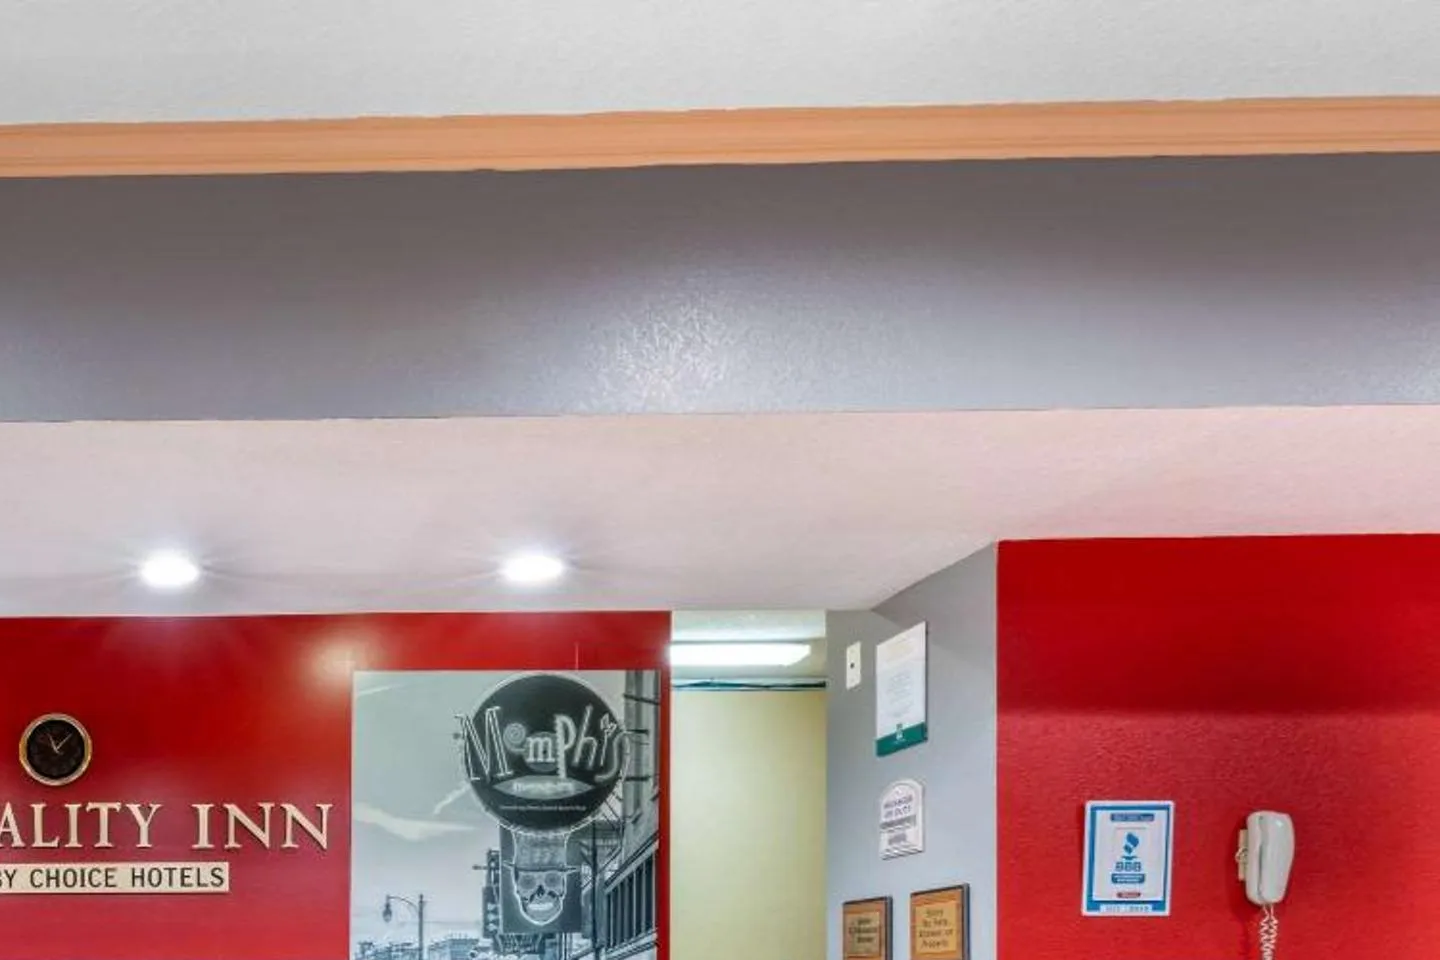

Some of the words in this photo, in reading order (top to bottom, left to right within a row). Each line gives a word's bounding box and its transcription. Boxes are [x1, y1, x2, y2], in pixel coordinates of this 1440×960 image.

[192, 802, 334, 850] INN
[30, 868, 117, 888] CHOICE
[131, 867, 225, 888] HOTELS
